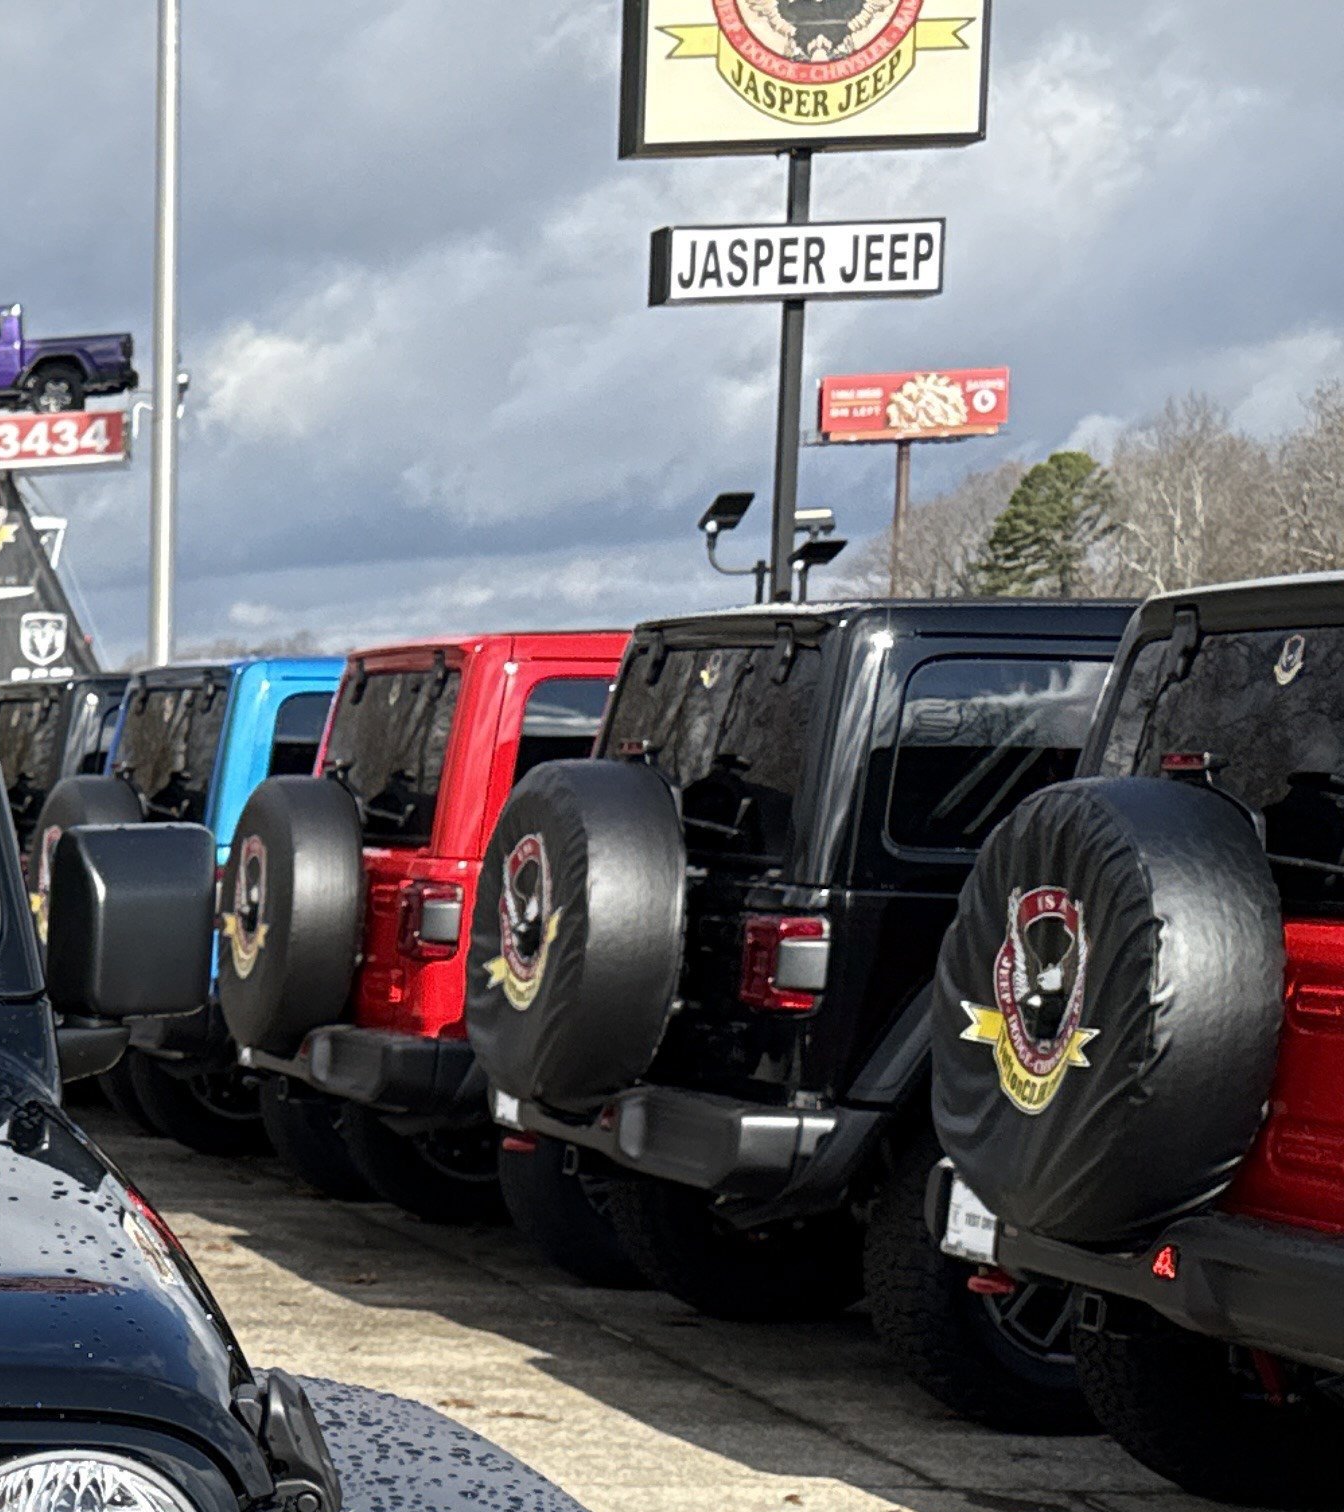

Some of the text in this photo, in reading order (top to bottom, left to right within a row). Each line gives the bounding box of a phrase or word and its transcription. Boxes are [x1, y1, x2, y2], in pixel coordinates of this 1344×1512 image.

[730, 49, 902, 117] JASPER JEEP
[677, 232, 935, 290] JASPER JEEP
